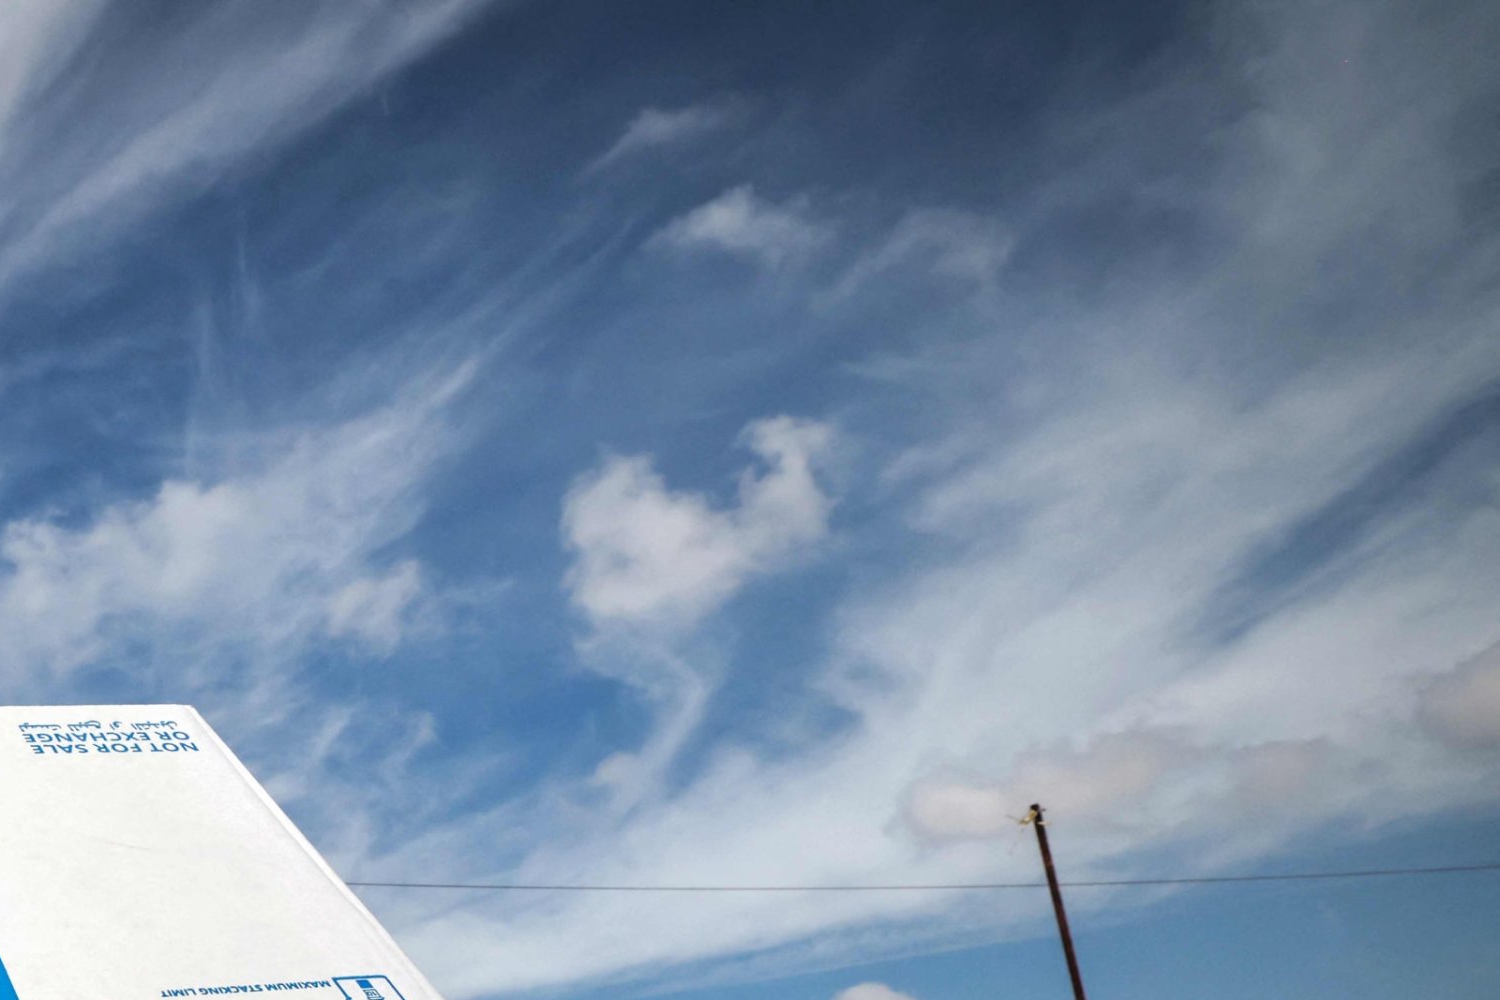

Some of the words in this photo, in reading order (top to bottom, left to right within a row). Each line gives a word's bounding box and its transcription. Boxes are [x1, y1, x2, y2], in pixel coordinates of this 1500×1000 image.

[18, 723, 61, 732] ليست
[67, 719, 102, 732] للبيع
[22, 732, 151, 743] EXCHANGE
[155, 731, 191, 742] OR
[30, 744, 90, 755] SALE
[93, 743, 143, 754] FOR
[150, 742, 200, 753] NOT
[199, 984, 263, 994] STACKING
[266, 980, 332, 991] MAXIMUM
[160, 988, 197, 997] LIMIT
